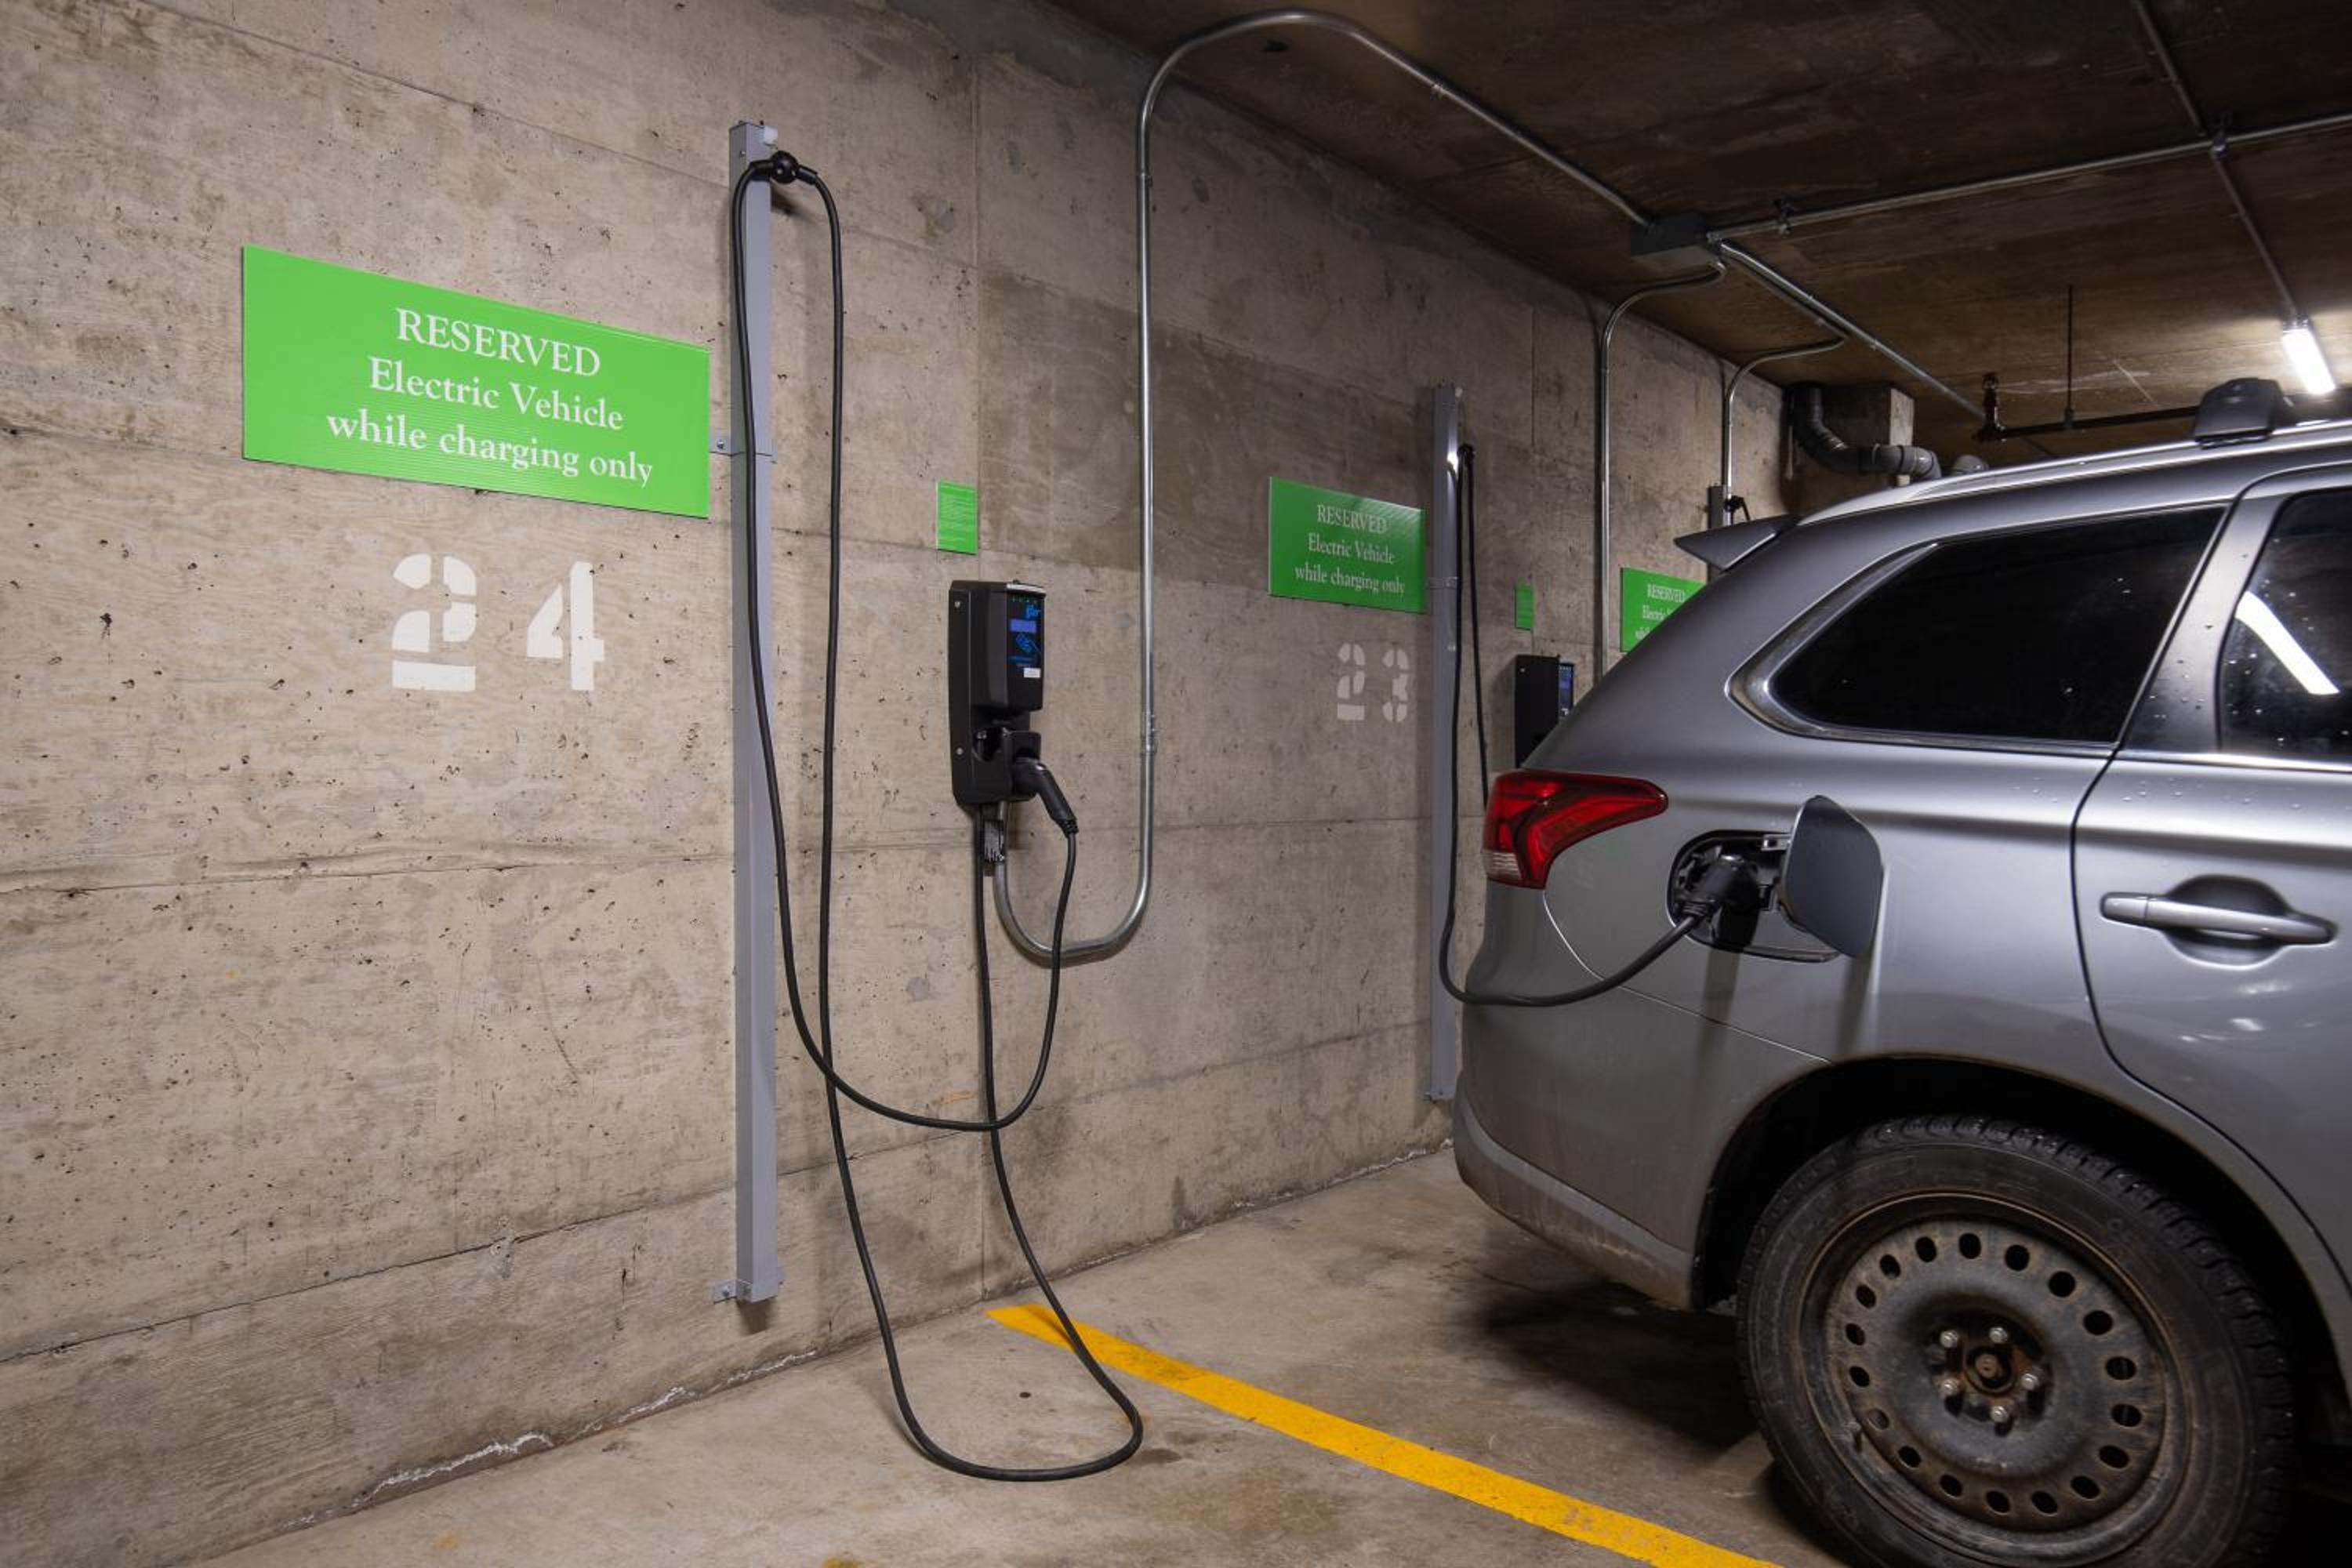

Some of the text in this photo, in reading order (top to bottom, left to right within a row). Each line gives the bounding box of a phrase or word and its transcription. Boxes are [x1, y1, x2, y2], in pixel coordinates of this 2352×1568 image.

[396, 307, 601, 376] RESERVED
[368, 356, 623, 430] Electric Vehicle
[327, 408, 652, 488] while charging only
[1308, 532, 1395, 564] Electric Vehicle
[1317, 504, 1387, 534] RESERVED
[1294, 562, 1405, 593] while charging only
[1337, 642, 1408, 723] 23
